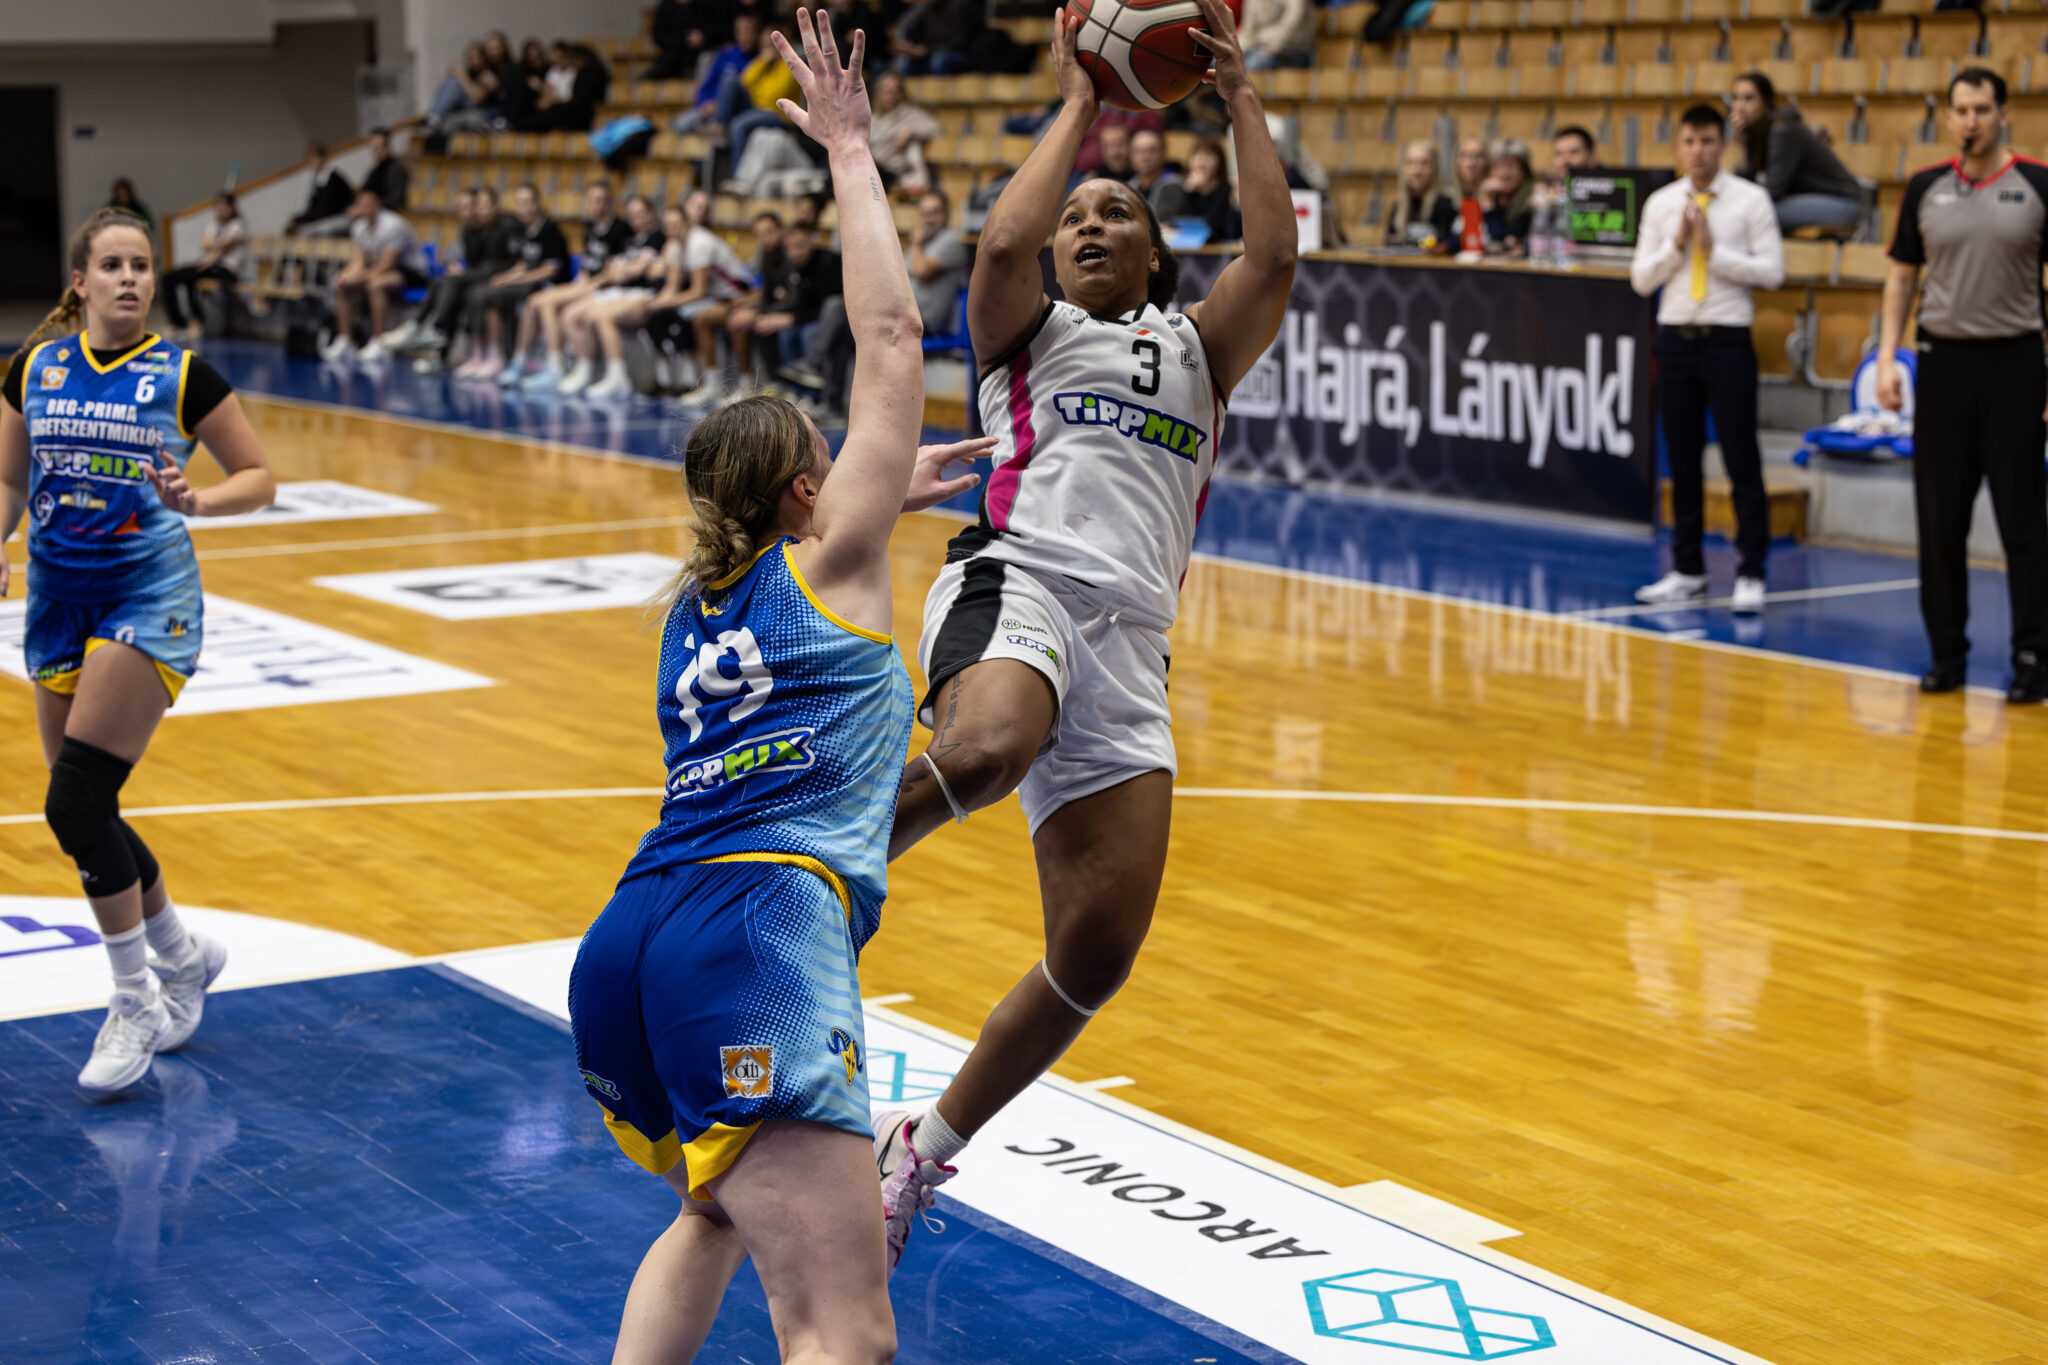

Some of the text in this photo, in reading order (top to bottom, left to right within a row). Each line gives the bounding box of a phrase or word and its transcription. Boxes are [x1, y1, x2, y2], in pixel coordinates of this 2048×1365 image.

[134, 374, 156, 403] 6
[1130, 338, 1162, 397] 3
[1284, 309, 1636, 469] Hajrá, Lányok!
[45, 398, 138, 422] BKG-PRIMA
[38, 449, 146, 480] TPPMIX
[674, 626, 774, 743] 19
[1003, 1137, 1332, 1260] ARCONIC
